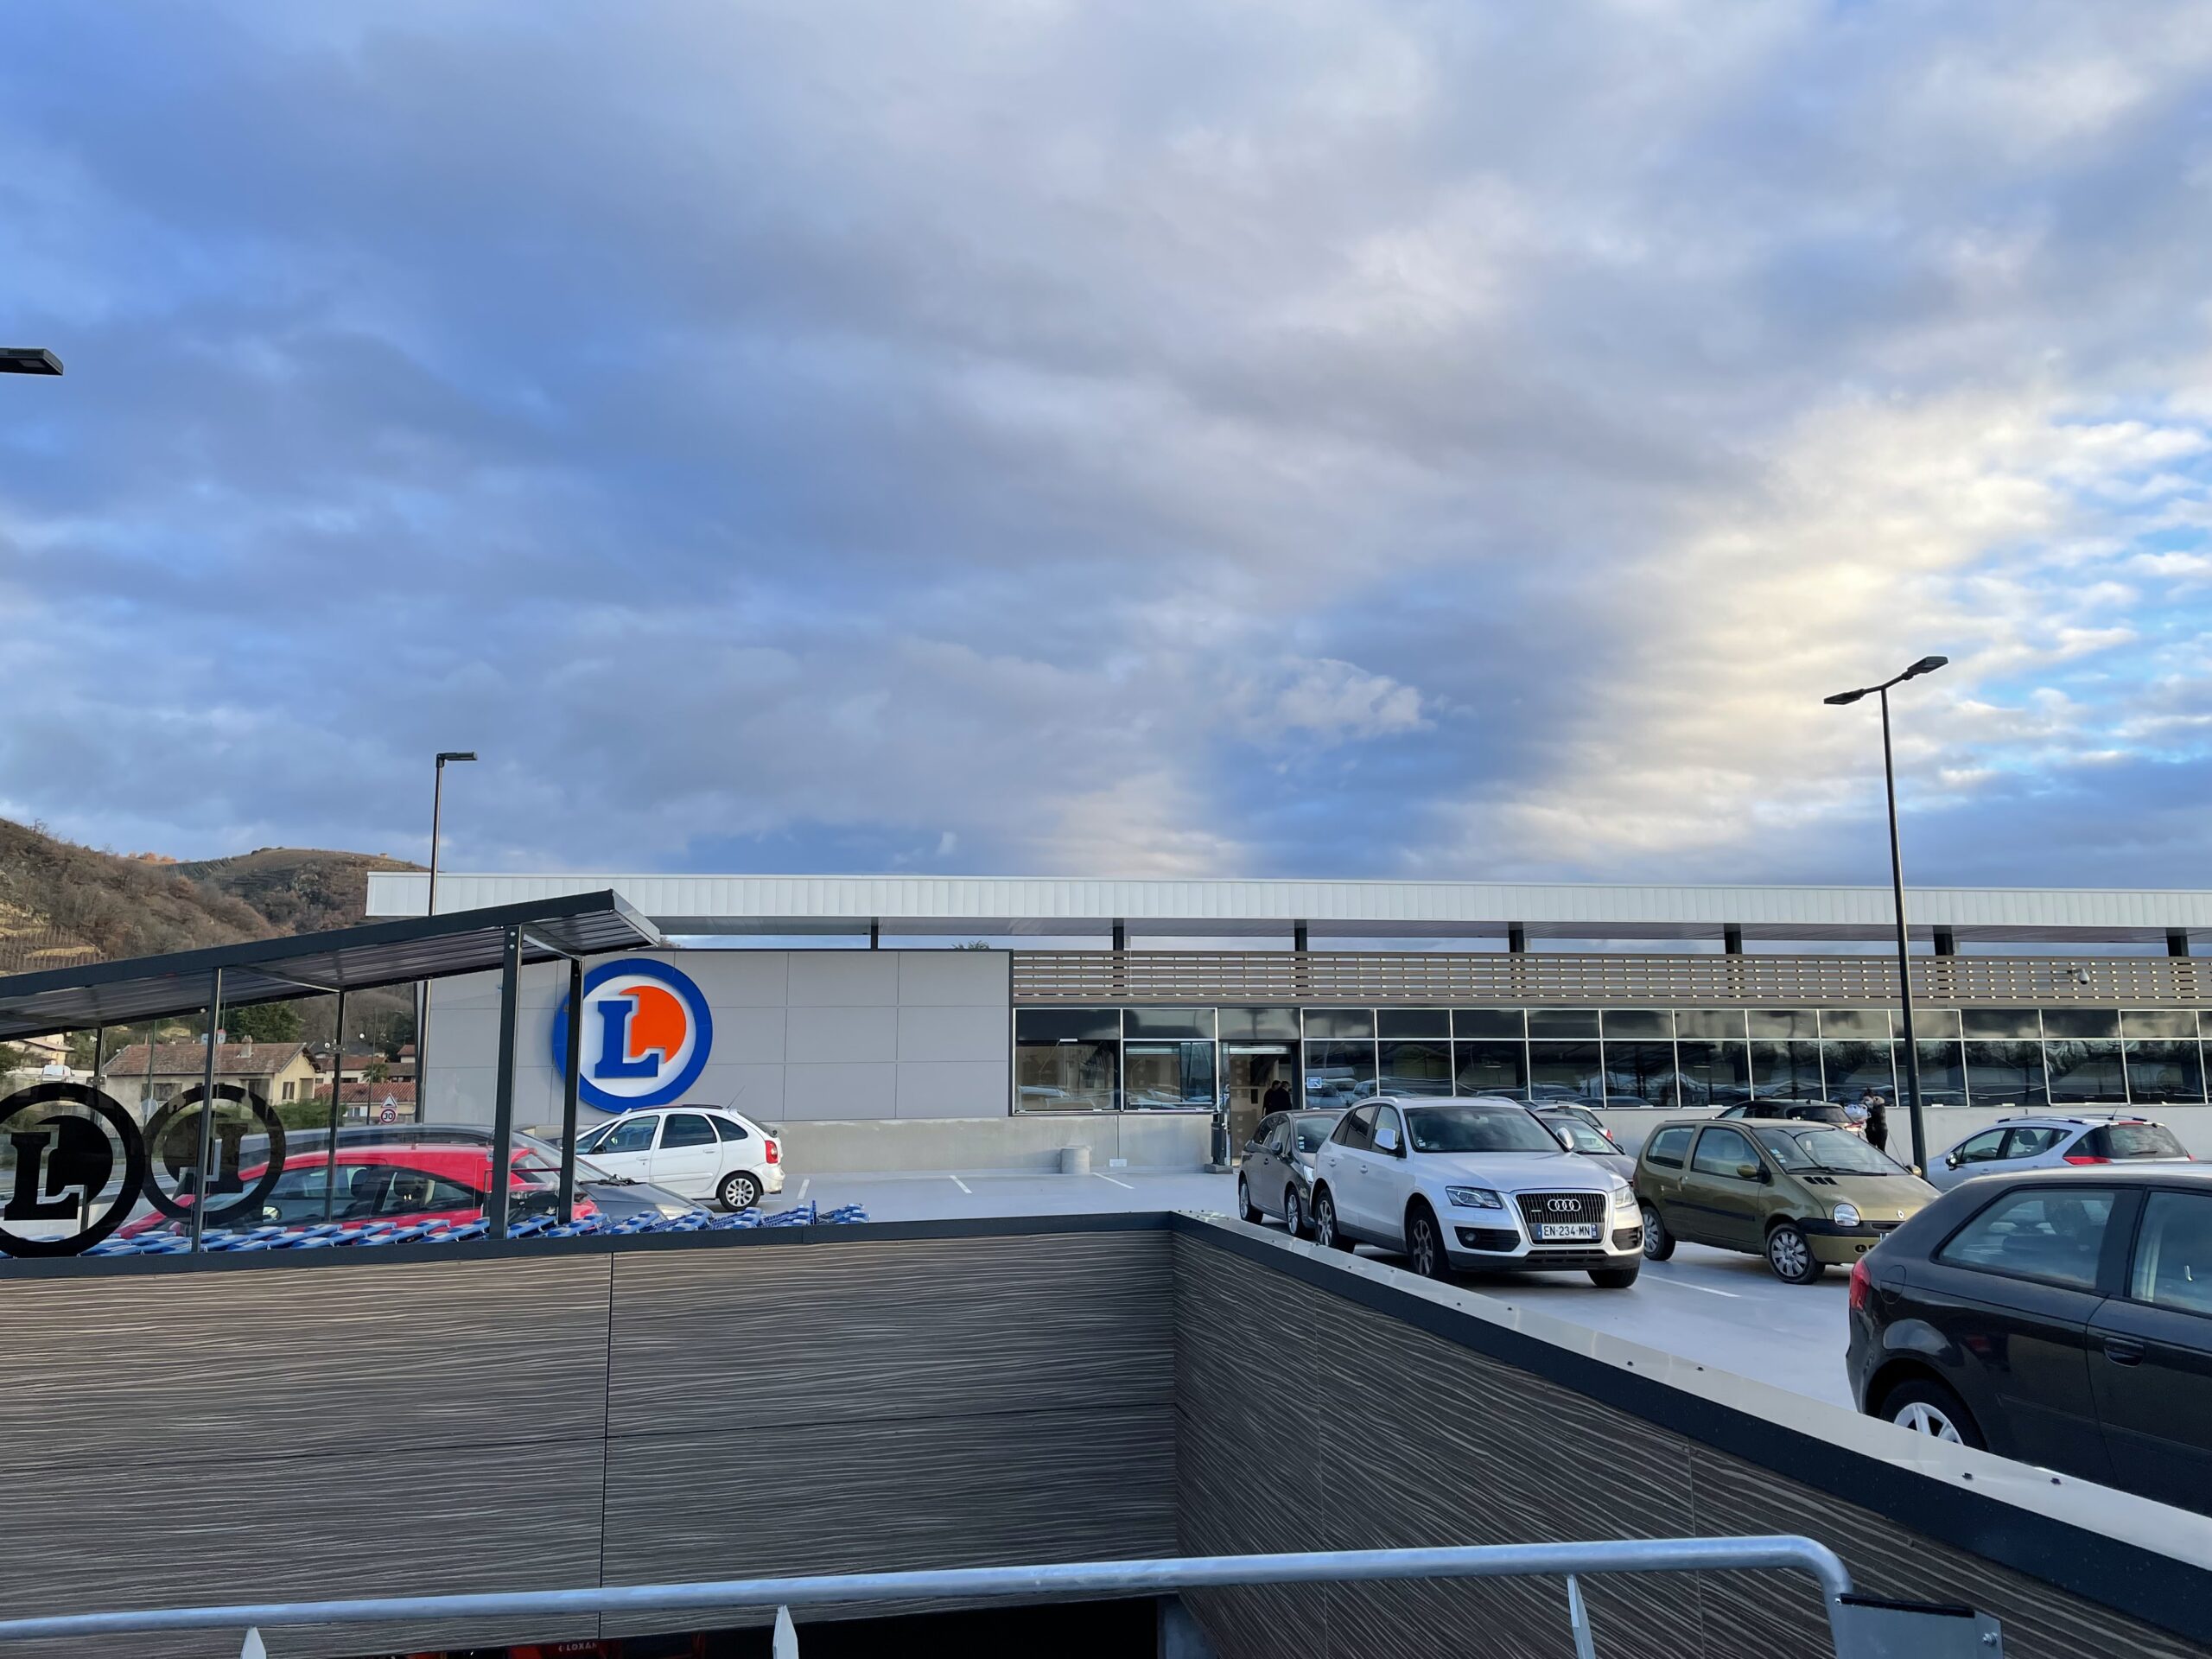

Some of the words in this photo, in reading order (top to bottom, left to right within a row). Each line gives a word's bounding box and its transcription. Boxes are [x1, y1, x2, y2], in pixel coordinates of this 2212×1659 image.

[594, 1001, 659, 1078] L
[4, 1132, 80, 1220] L
[1543, 1225, 1590, 1236] EN-234-MN
